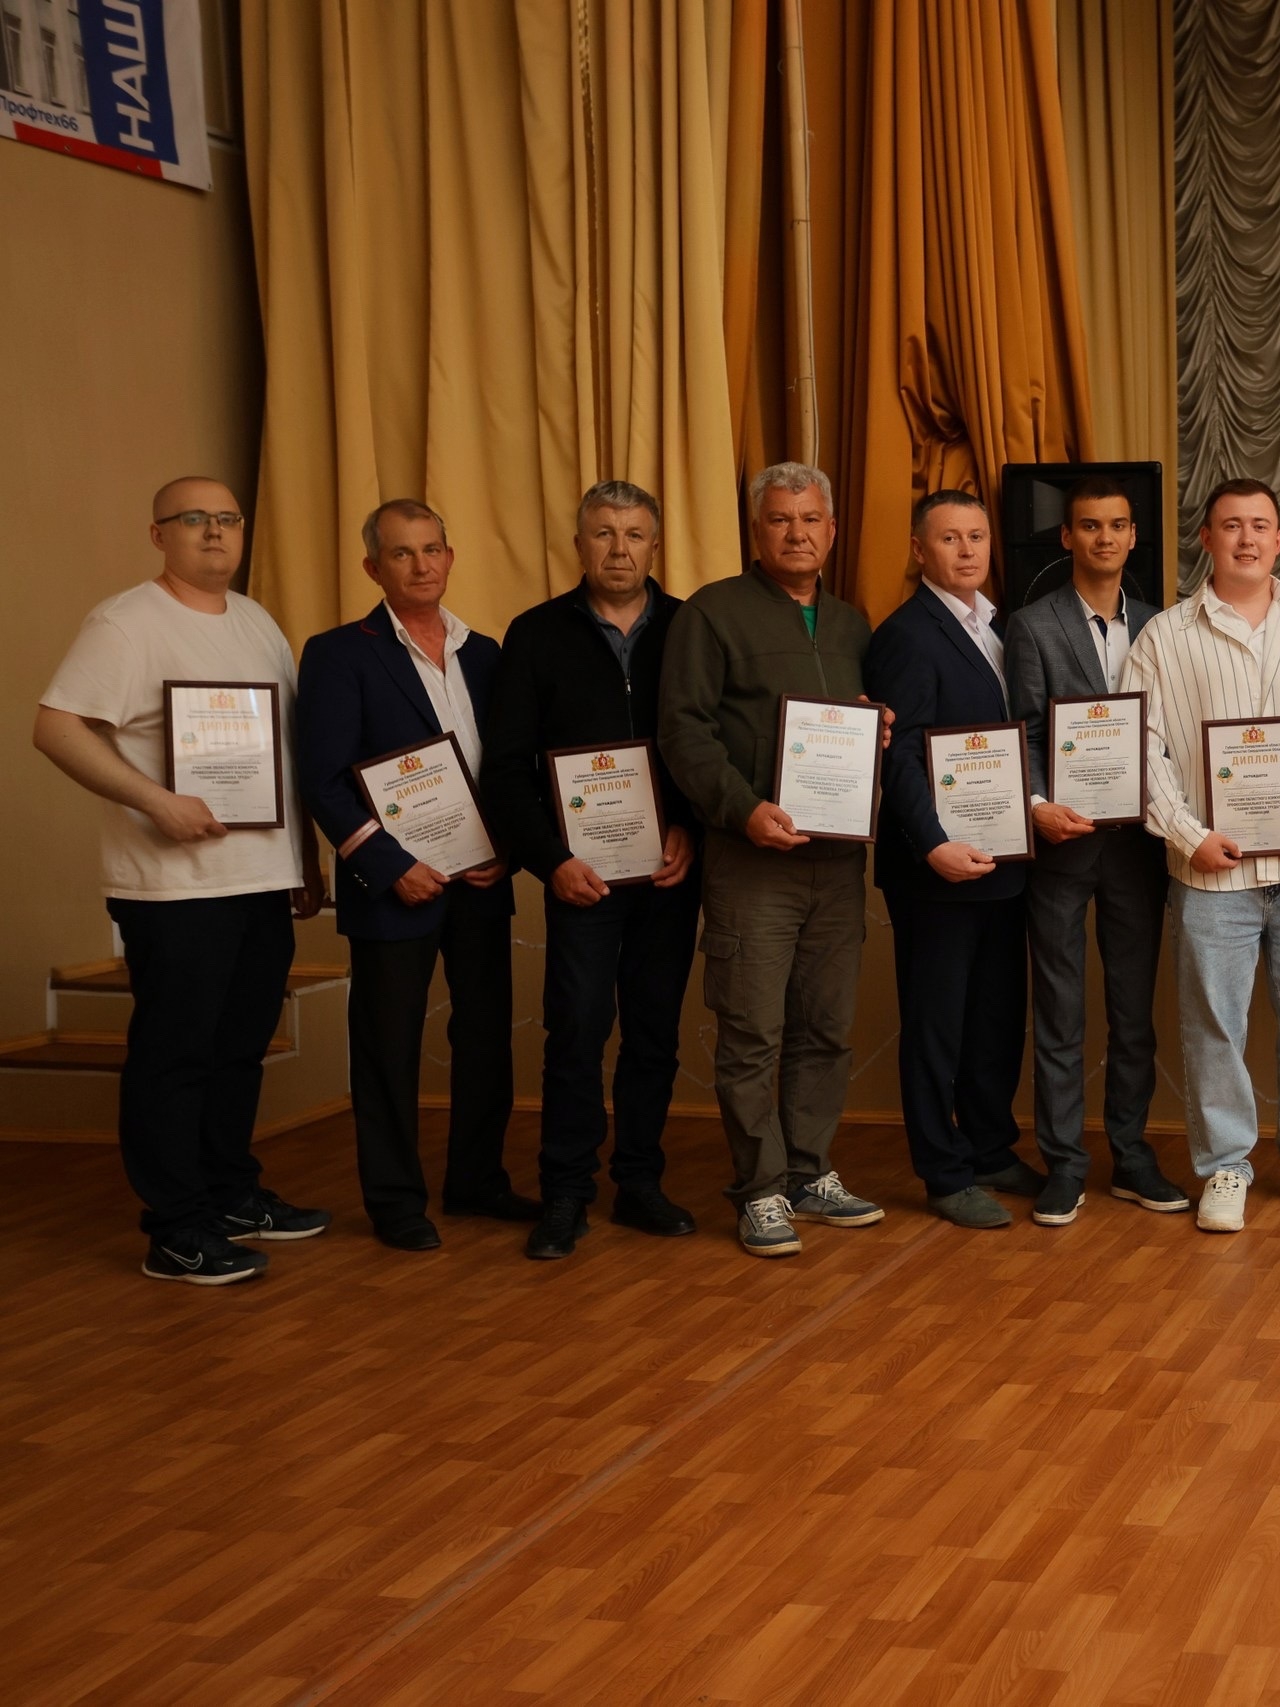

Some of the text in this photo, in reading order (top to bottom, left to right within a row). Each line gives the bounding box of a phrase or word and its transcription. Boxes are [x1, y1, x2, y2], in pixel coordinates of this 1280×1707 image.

[101, 0, 155, 152] НАШ
[806, 734, 854, 746] ДИПЛОМ
[1076, 728, 1120, 741] ДИПЛОМ
[955, 760, 1001, 774] ДИПЛОМ
[1232, 754, 1278, 767] ДИПЛОМ
[395, 775, 444, 801] ДИПЛОМ
[584, 779, 631, 796] ДИПЛОМ
